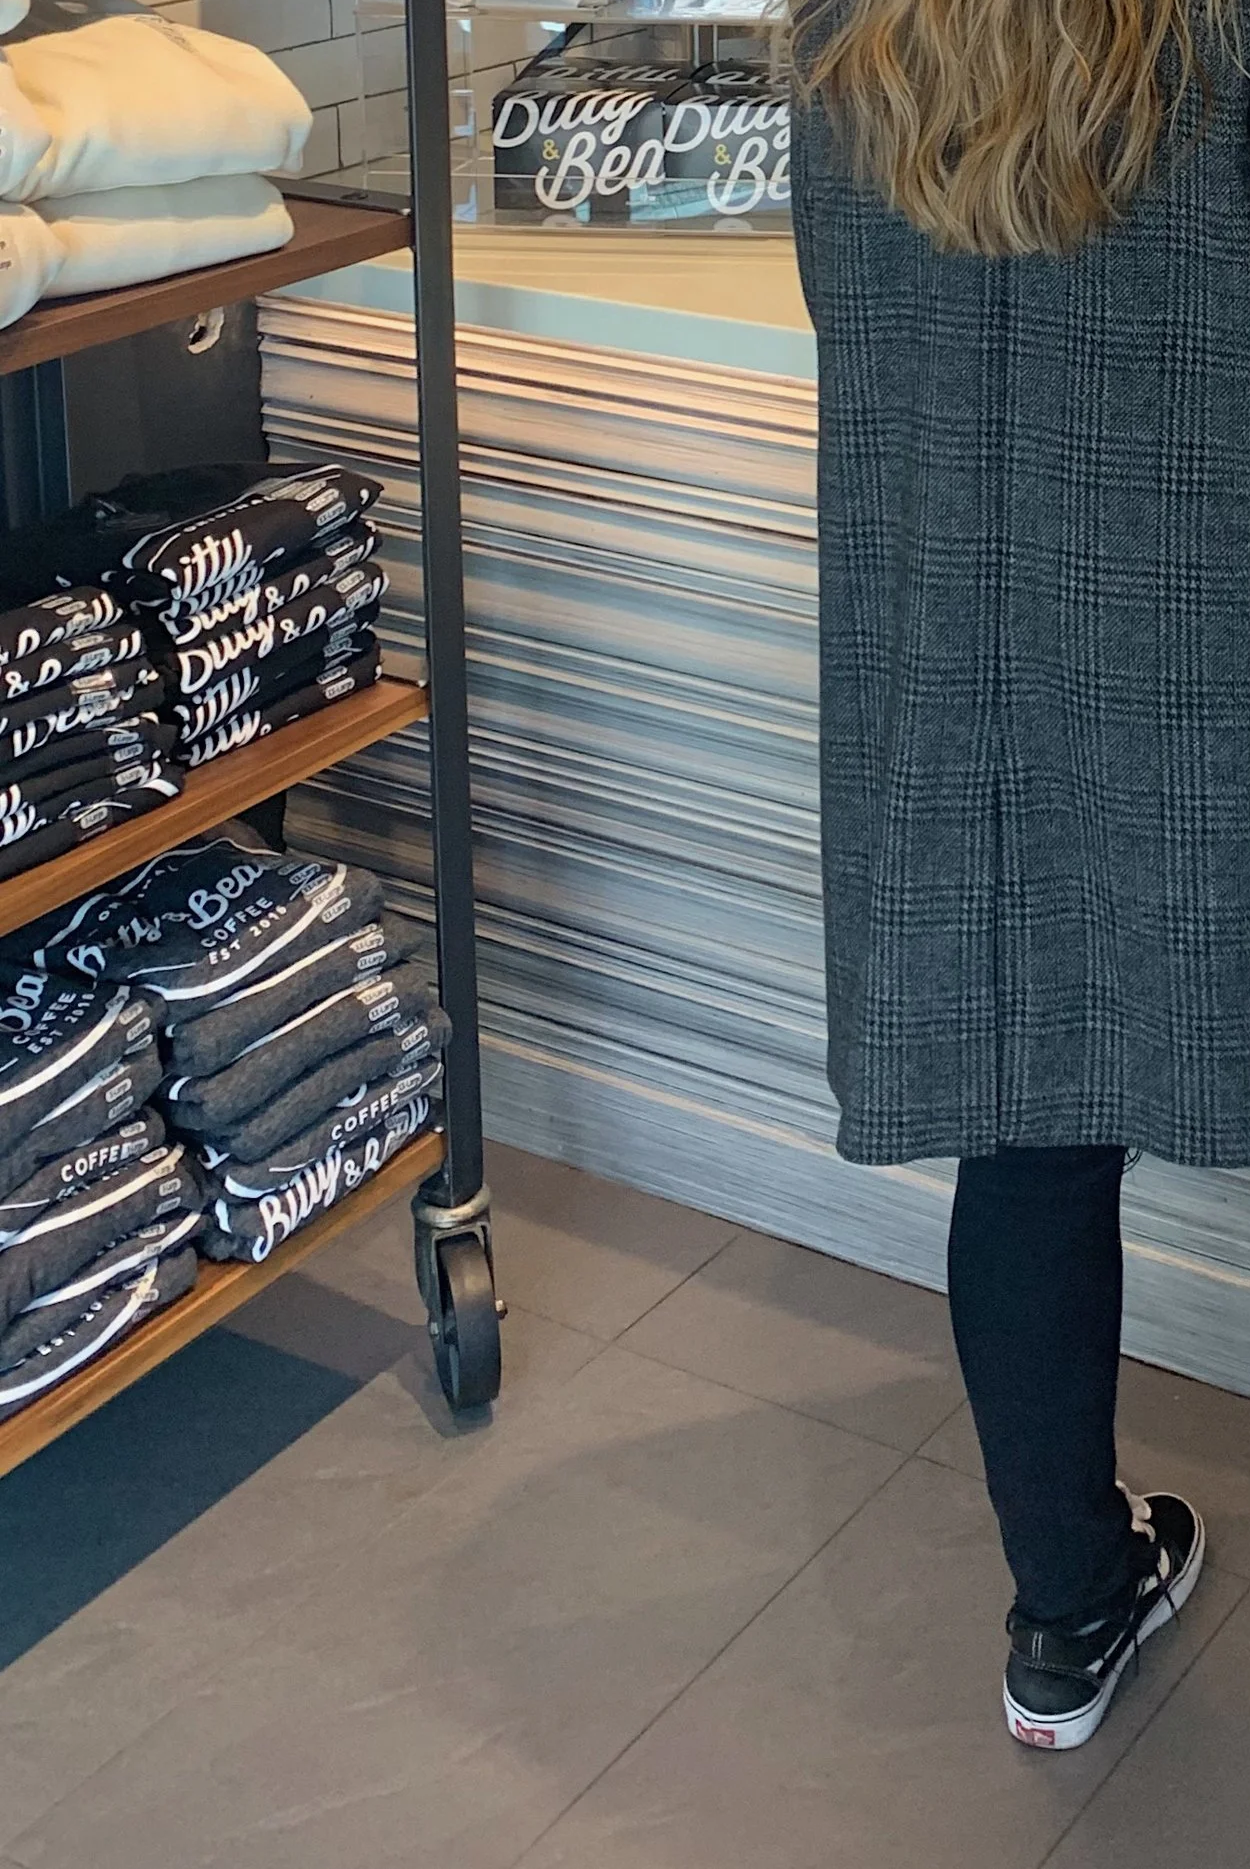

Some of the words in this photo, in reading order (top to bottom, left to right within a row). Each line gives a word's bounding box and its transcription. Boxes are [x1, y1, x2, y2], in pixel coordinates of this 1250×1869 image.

[542, 139, 560, 161] &
[201, 897, 273, 948] COFFEE
[208, 942, 241, 966] EST
[331, 1087, 400, 1141] COFFEE
